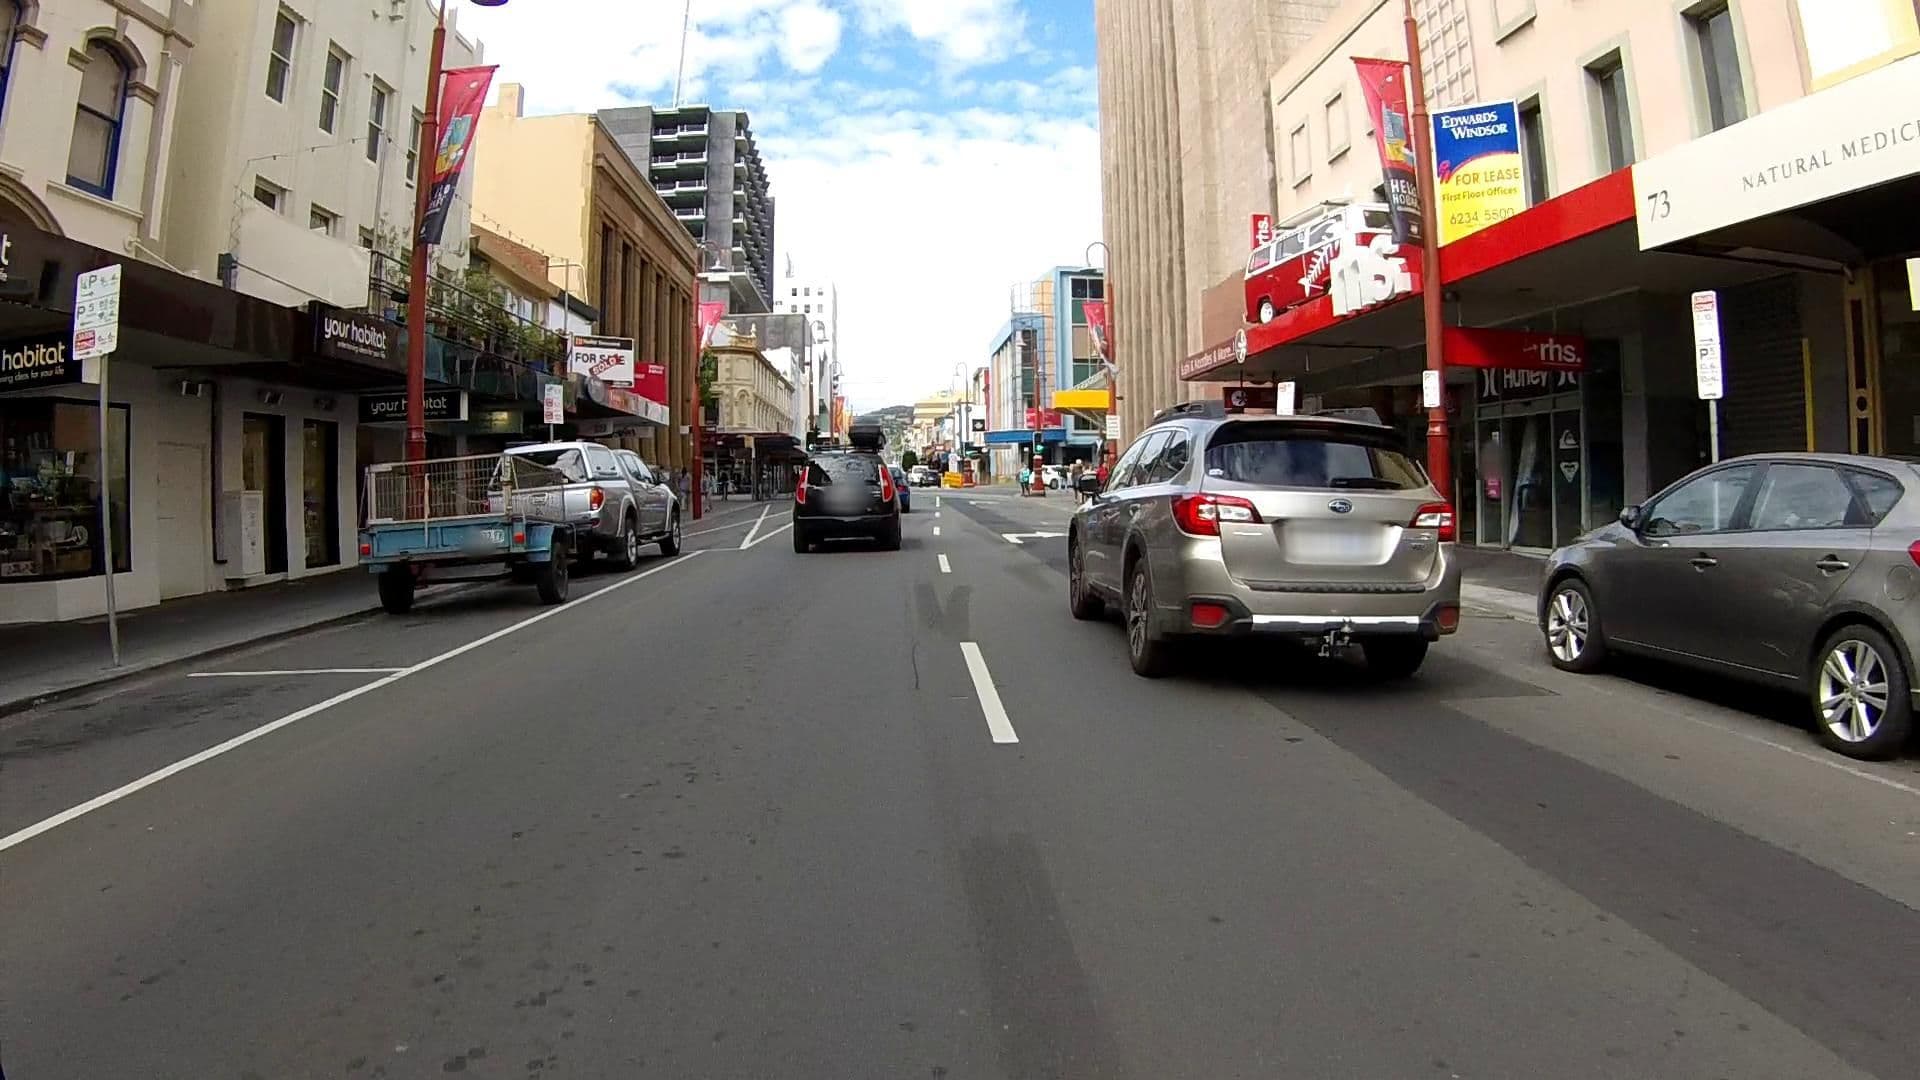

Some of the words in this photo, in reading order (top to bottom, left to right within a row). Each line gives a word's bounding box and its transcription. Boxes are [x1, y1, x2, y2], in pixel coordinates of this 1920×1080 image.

[1441, 111, 1498, 129] EDWARDS
[1451, 123, 1508, 139] WINDSOR
[1456, 173, 1480, 186] FOR
[1484, 168, 1520, 183] LEASE
[1742, 150, 1833, 192] NATURAL
[1647, 189, 1671, 223] 73
[324, 317, 350, 338] your
[351, 320, 387, 350] habitat
[2, 342, 65, 371] habitat
[575, 352, 596, 363] FOR
[599, 354, 625, 365] SE
[1540, 338, 1582, 363] rhs.
[592, 357, 617, 374] SOLD
[371, 401, 399, 415] your
[402, 397, 447, 410] hitat
